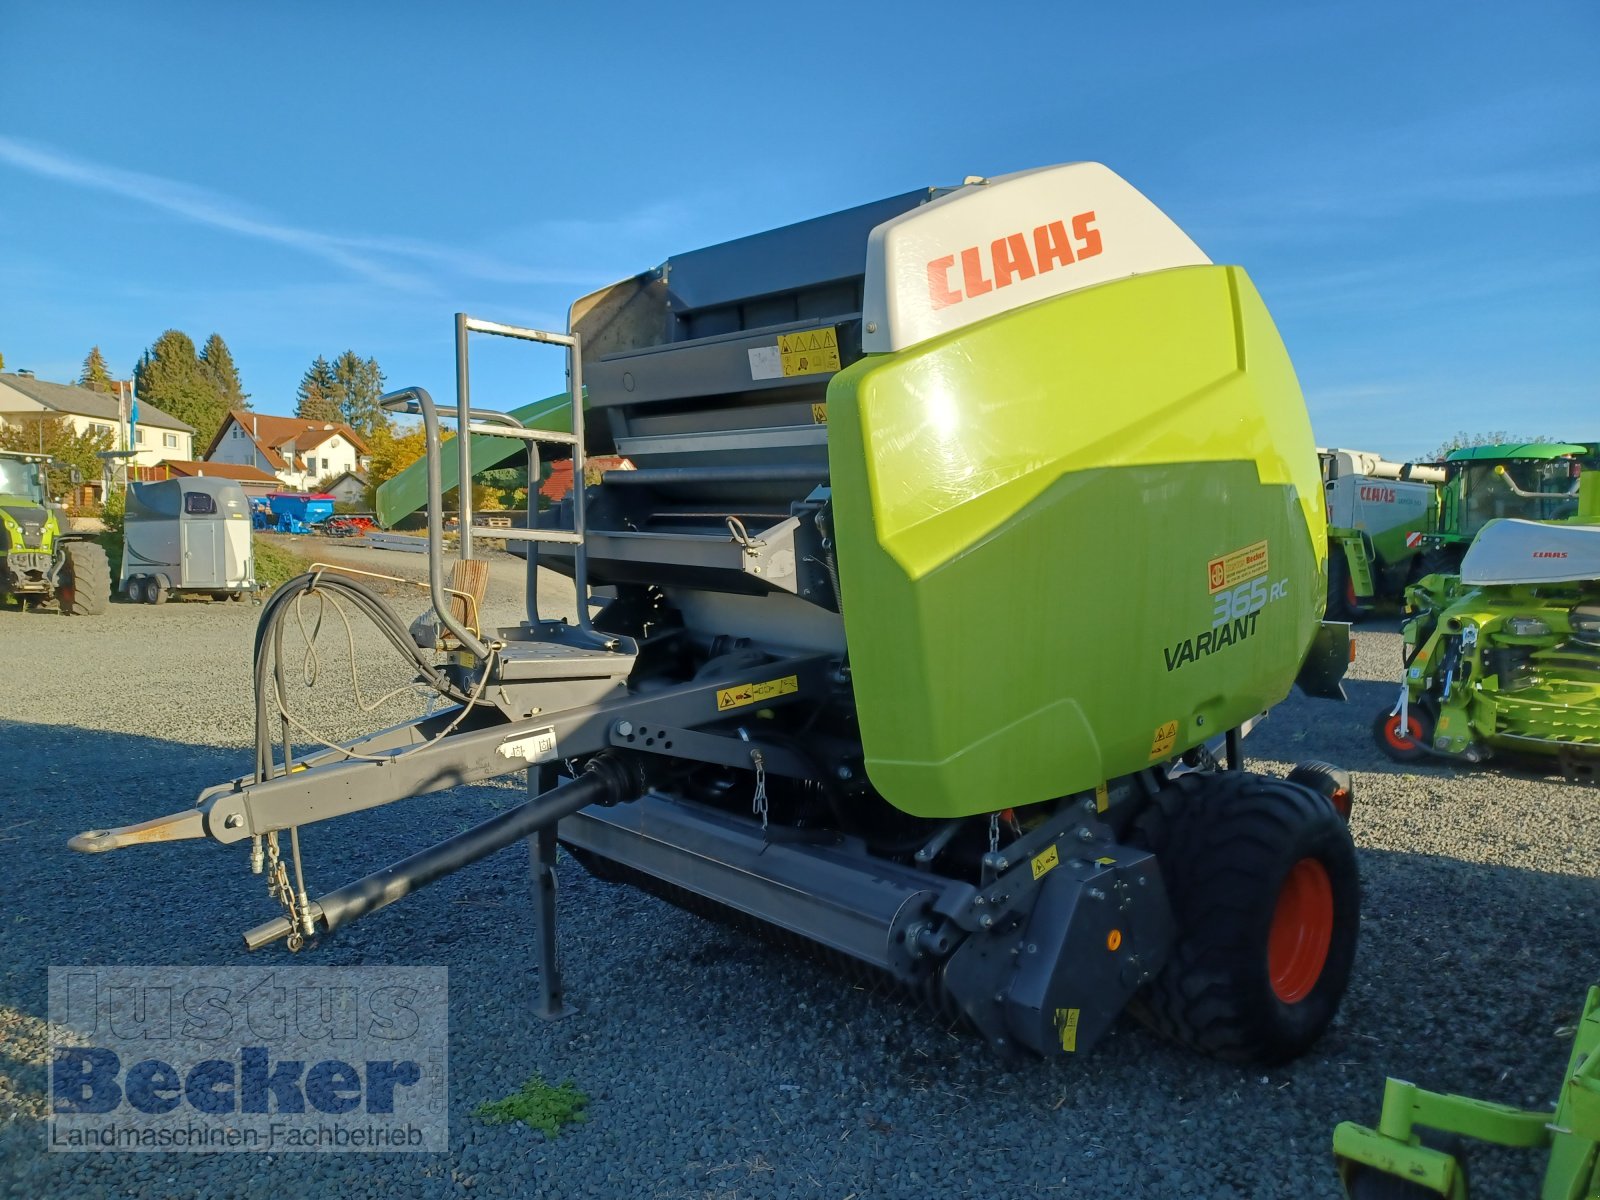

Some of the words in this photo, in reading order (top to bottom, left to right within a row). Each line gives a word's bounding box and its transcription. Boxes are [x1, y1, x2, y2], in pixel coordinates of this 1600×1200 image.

[927, 211, 1103, 311] CLAAS
[1360, 487, 1396, 503] CLAAS
[1532, 551, 1568, 559] CLAAS
[1212, 575, 1267, 629] 365
[1269, 578, 1289, 602] RC
[1163, 609, 1261, 673] VARIANT
